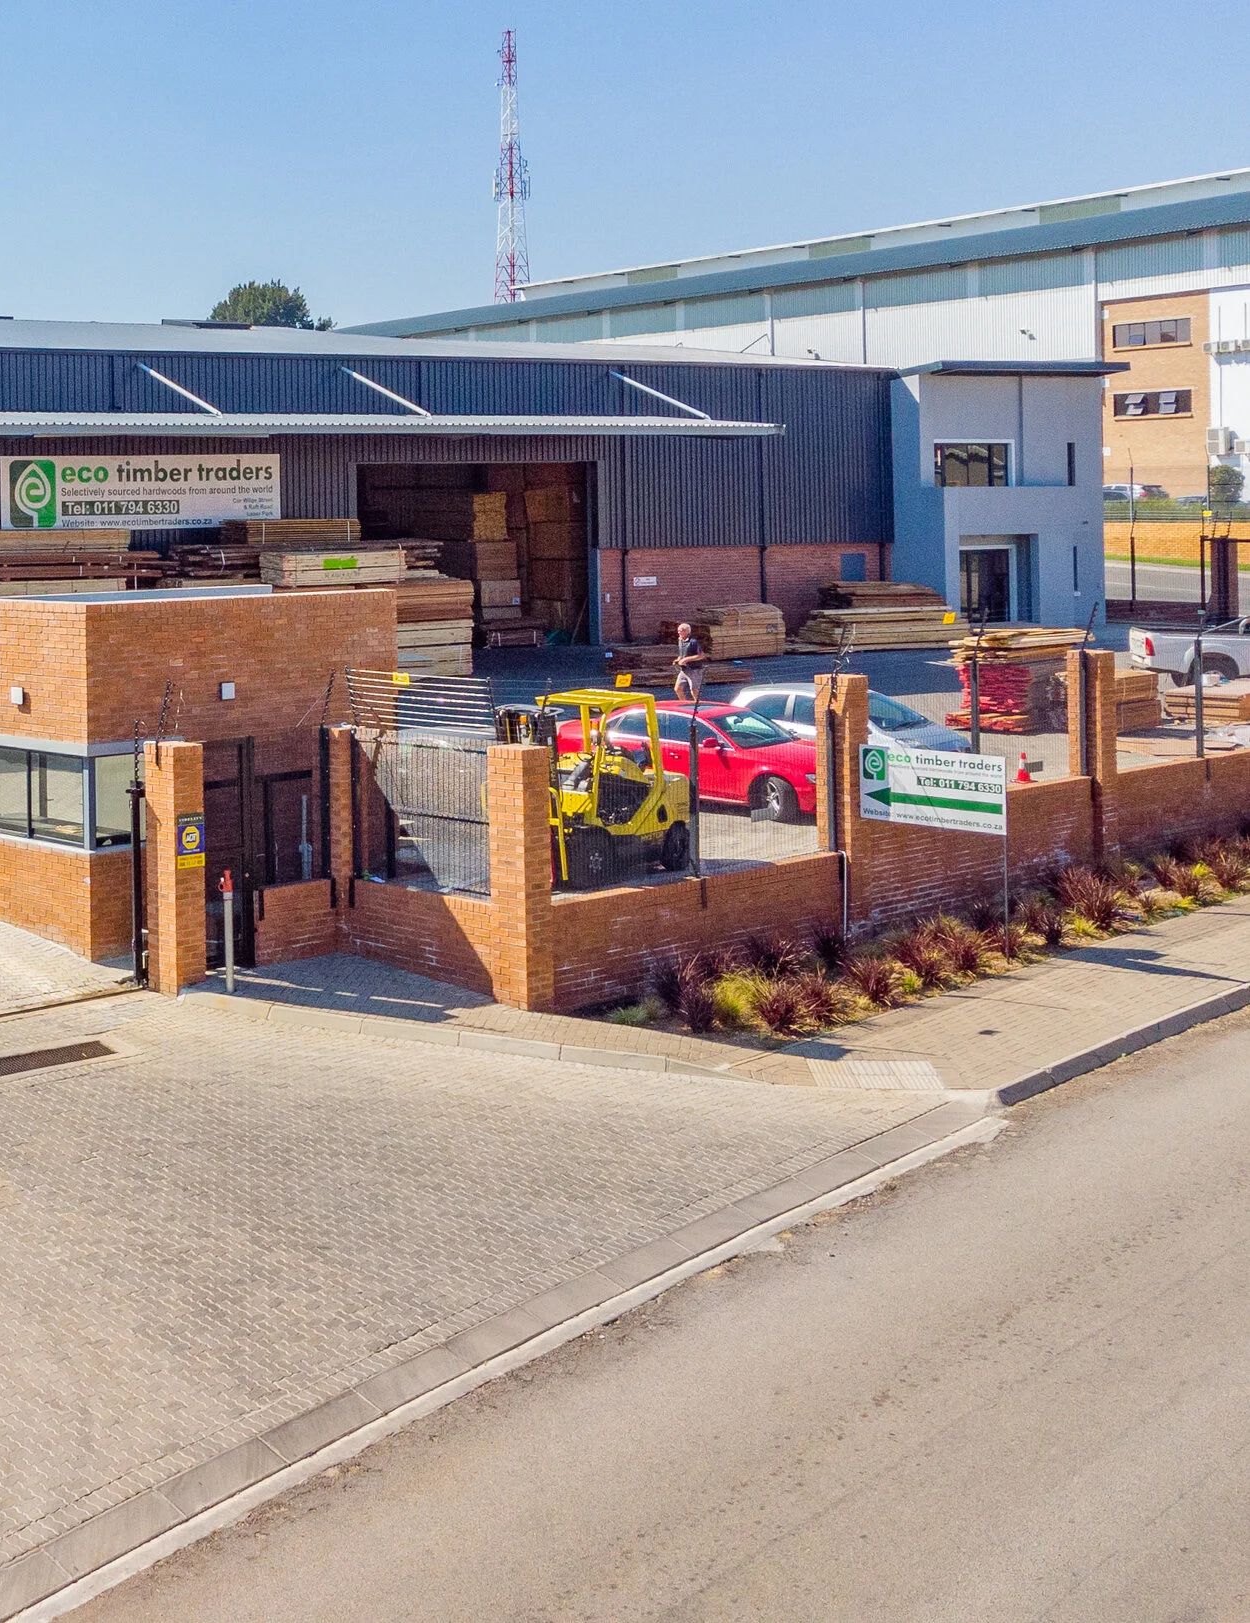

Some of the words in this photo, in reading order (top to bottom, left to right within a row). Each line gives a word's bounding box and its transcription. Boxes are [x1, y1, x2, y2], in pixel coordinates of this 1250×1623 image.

[61, 466, 109, 483] eco
[117, 460, 192, 482] timber
[197, 459, 273, 481] traders
[61, 487, 106, 498] Selectively
[108, 487, 141, 496] sourced
[142, 486, 186, 496] hardwoods
[189, 486, 207, 495] from
[208, 486, 236, 495] around
[238, 485, 251, 494] the
[252, 485, 273, 494] world
[65, 502, 90, 515] Tel:
[93, 501, 116, 514] 011
[120, 501, 144, 514] 794
[147, 500, 178, 514] 6330
[62, 519, 98, 528] Website:
[100, 518, 213, 528] www.ecotimbertraders.co.za
[888, 753, 911, 763] eco
[915, 754, 956, 767] timber
[959, 759, 1003, 772] traders
[918, 777, 937, 787] Tel:
[938, 779, 955, 789] 011
[958, 781, 976, 791] 794
[977, 783, 1002, 794] 6330
